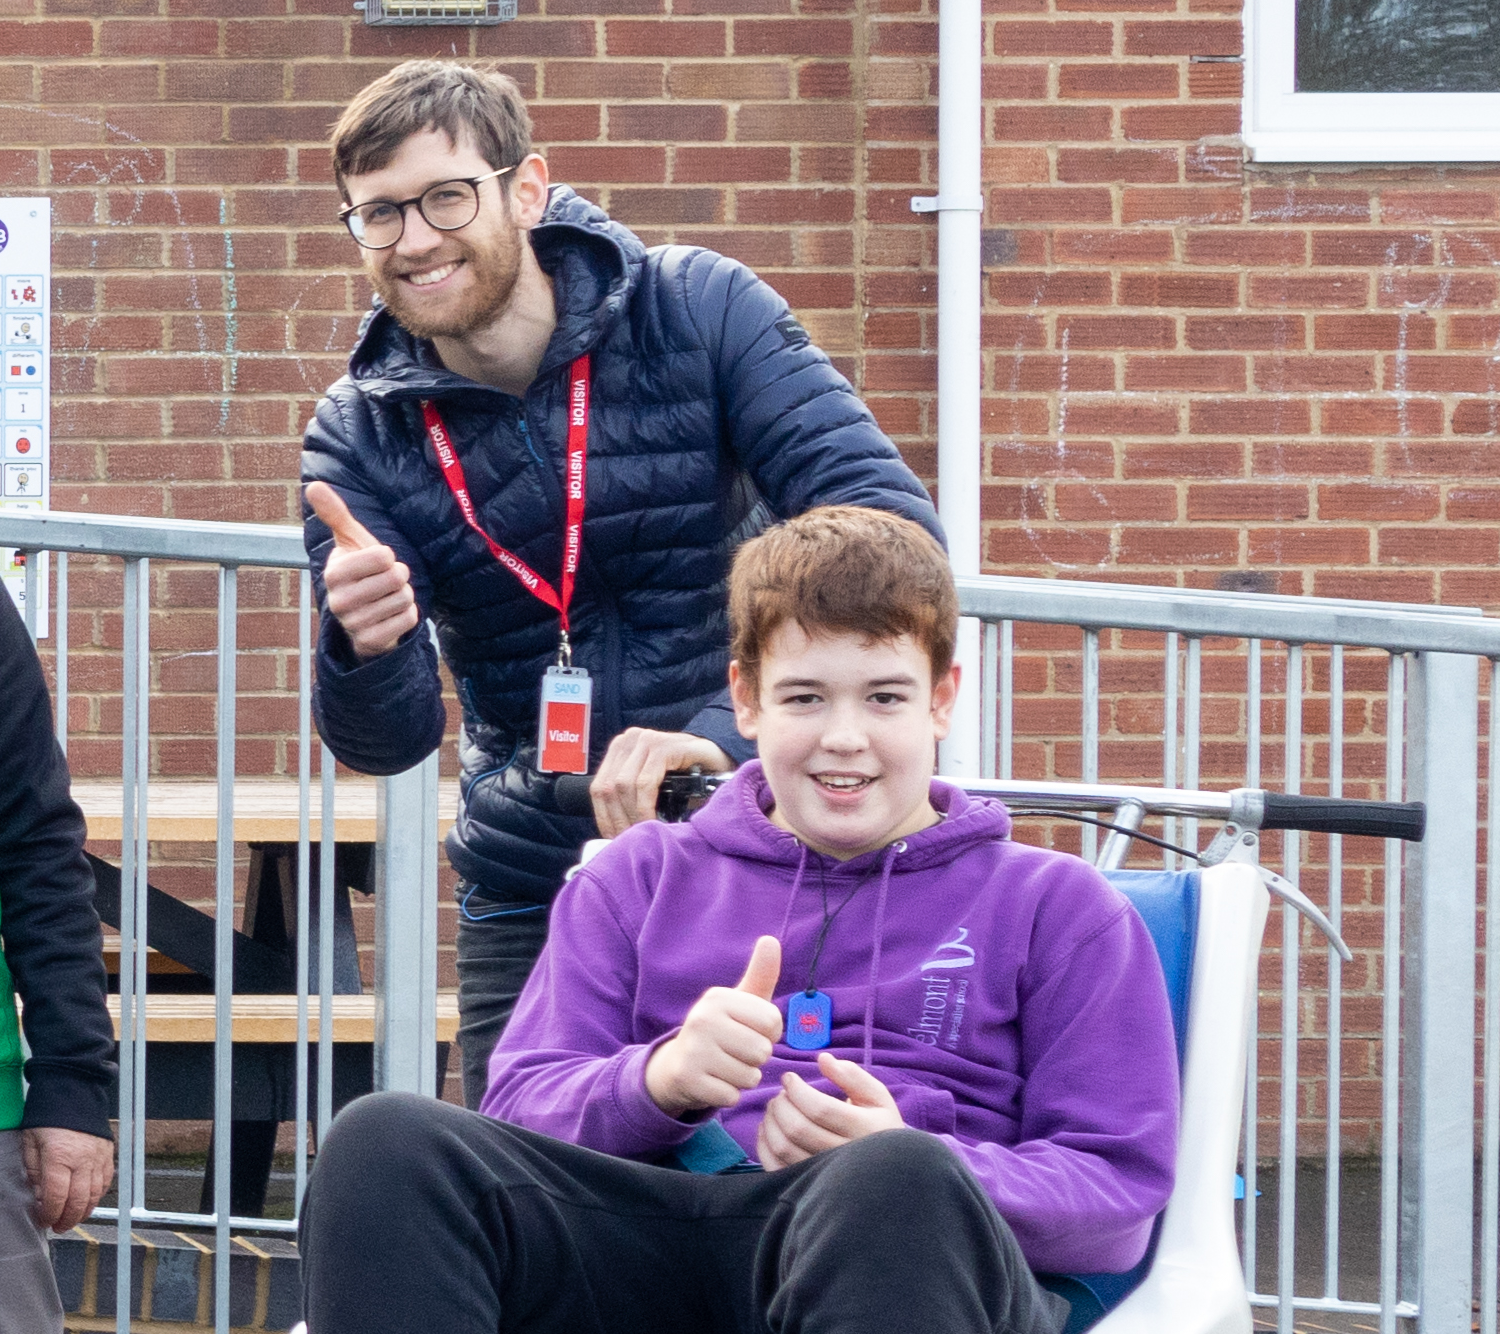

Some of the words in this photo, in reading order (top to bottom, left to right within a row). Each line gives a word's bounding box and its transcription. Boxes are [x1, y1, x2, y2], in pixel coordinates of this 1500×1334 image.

[573, 379, 585, 426] VISITOR
[429, 424, 455, 468] VISITOR
[571, 450, 583, 499] VISITOR
[499, 550, 539, 589] VISITOR
[566, 524, 579, 573] VISITOR
[554, 682, 580, 694] SAND
[548, 729, 580, 743] Visitor
[907, 975, 951, 1047] elmont
